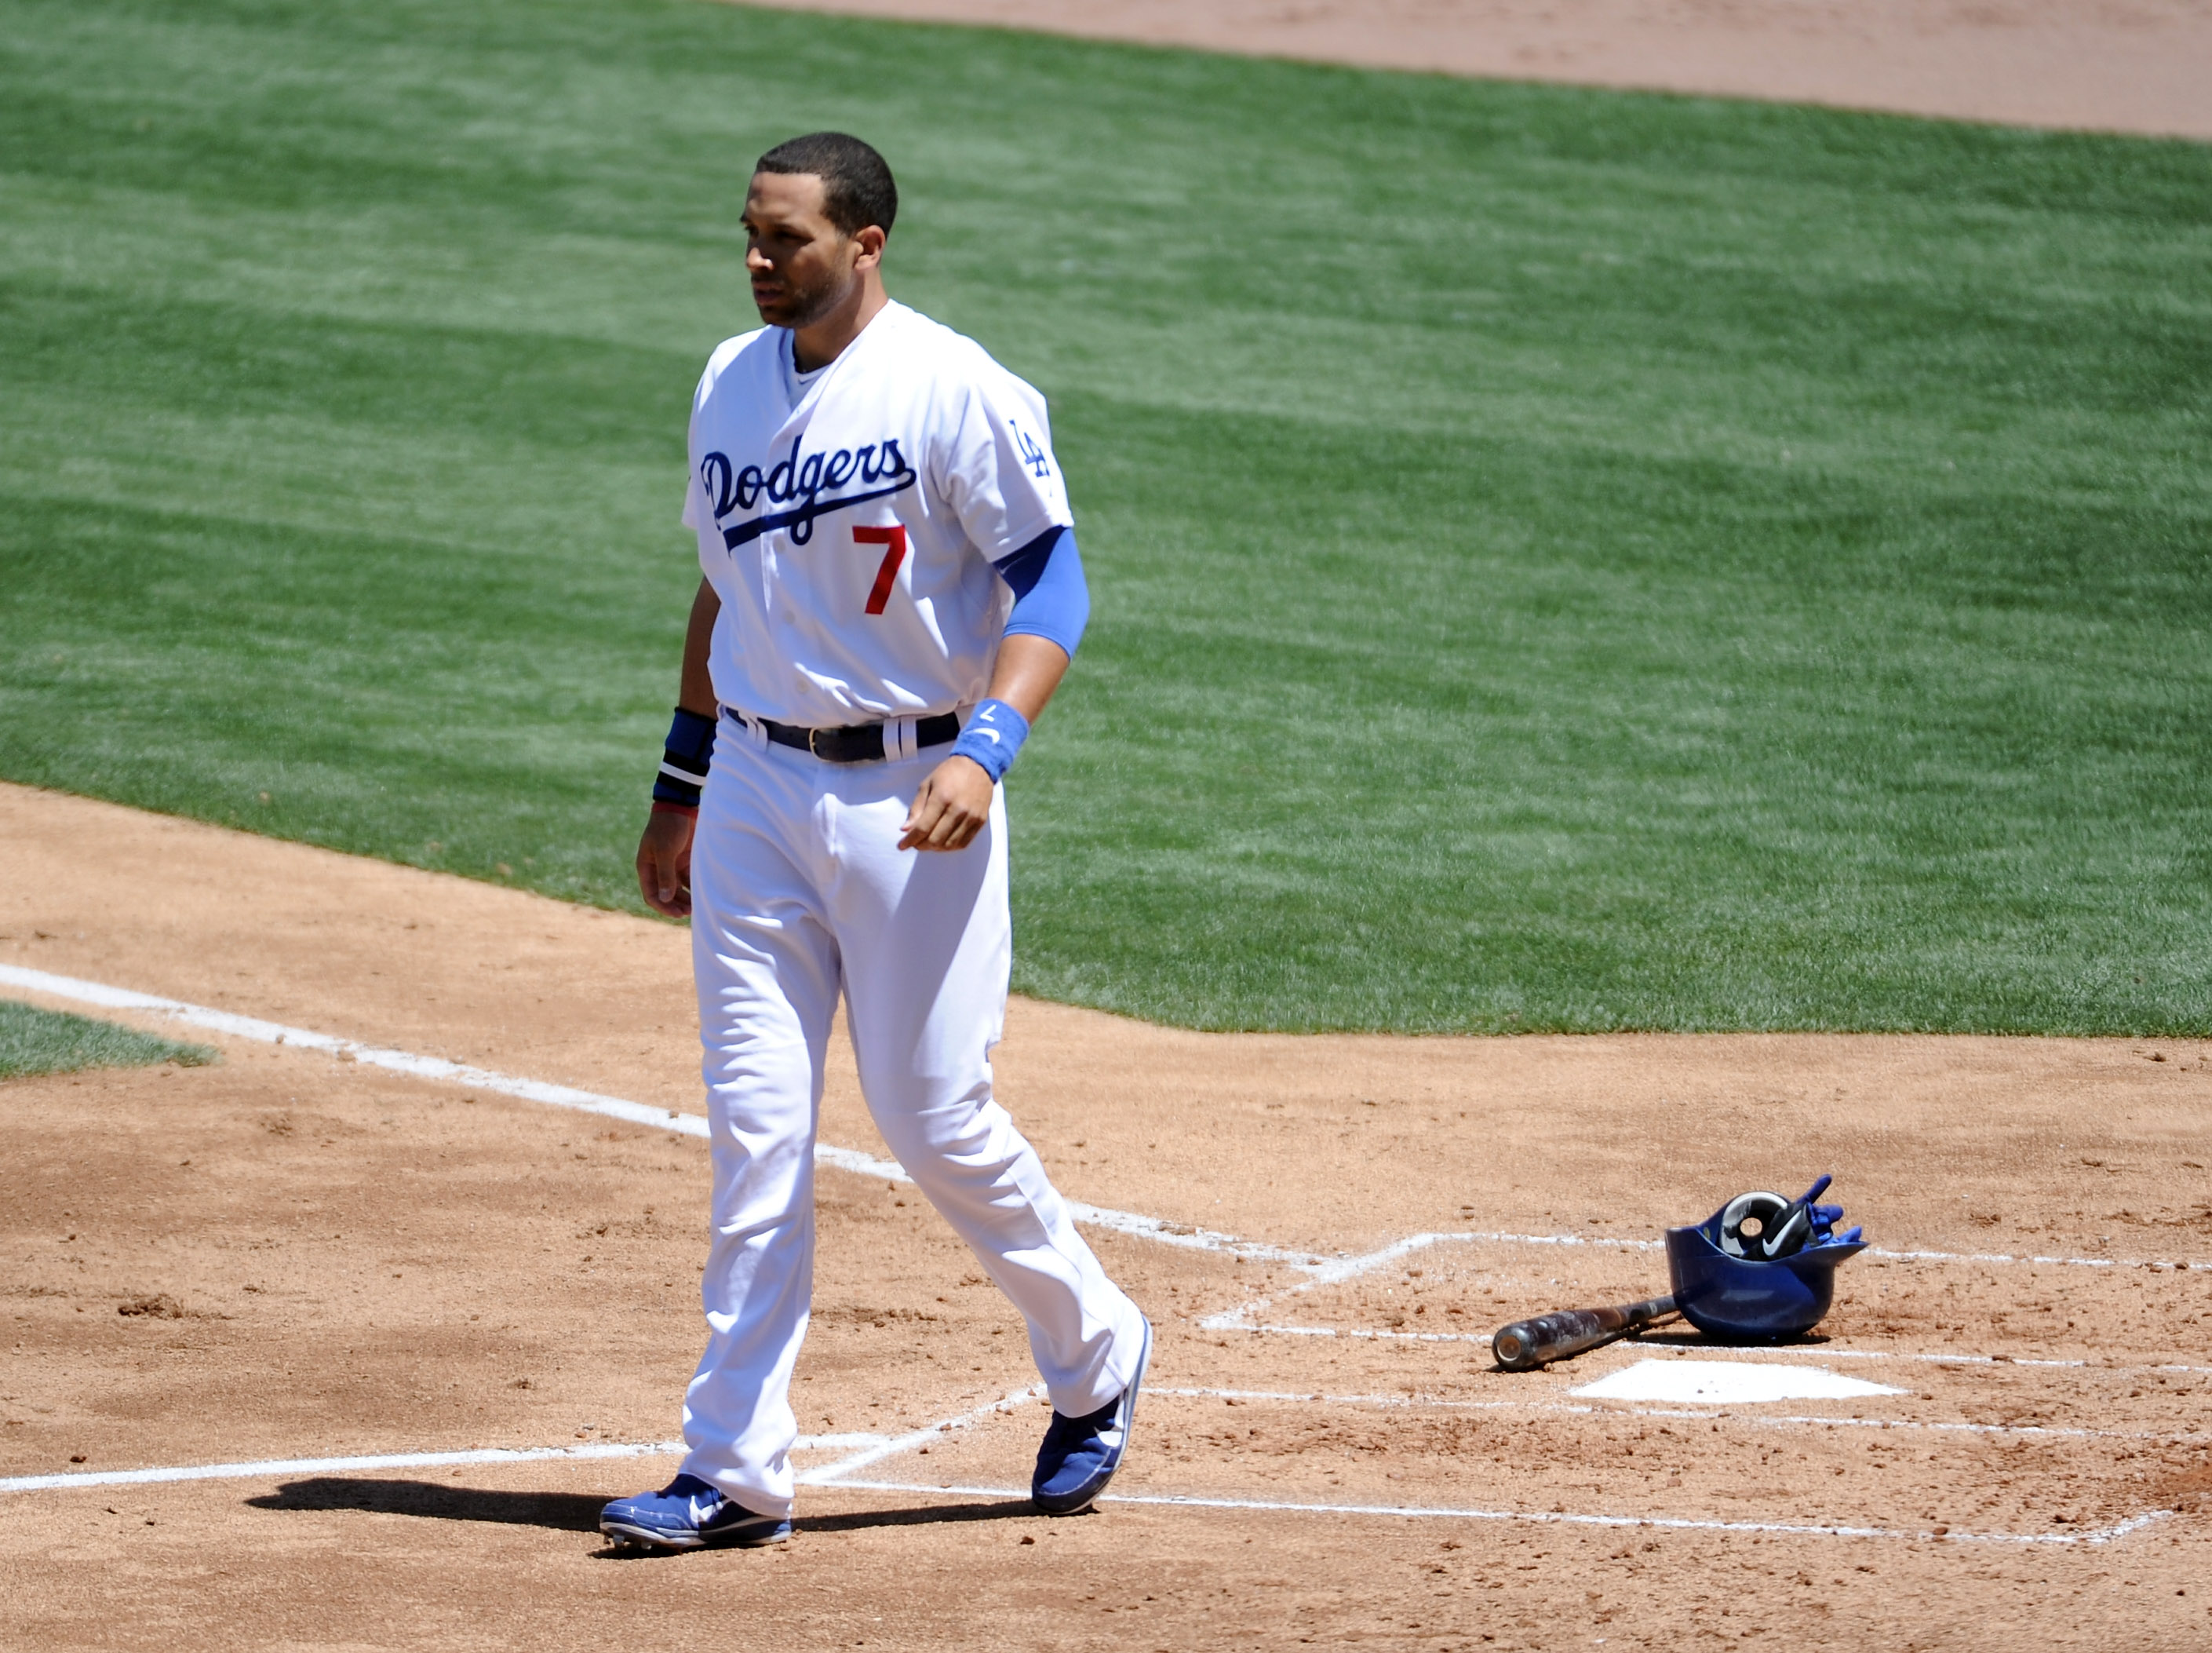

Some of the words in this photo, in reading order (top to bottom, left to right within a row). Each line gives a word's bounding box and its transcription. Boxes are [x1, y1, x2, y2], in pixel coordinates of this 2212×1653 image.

[700, 433, 913, 546] Dodgers
[1008, 419, 1050, 477] LA
[852, 524, 907, 615] 7
